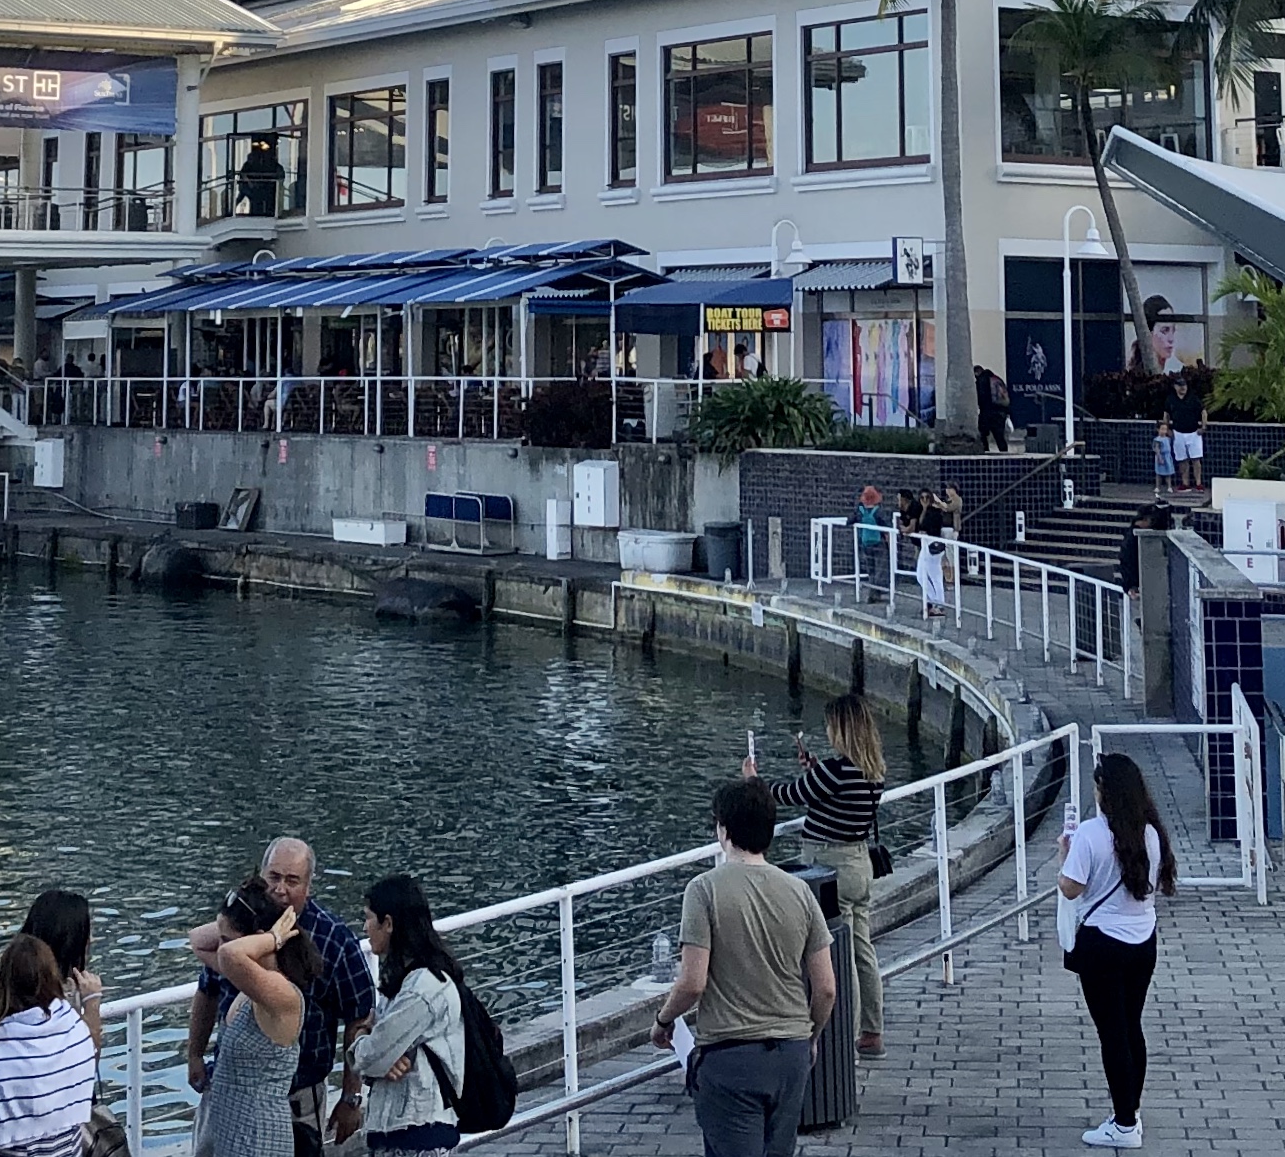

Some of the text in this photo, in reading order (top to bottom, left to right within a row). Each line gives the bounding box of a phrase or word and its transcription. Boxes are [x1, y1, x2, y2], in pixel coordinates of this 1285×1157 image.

[706, 307, 763, 319] BOAT TOUR
[707, 318, 742, 331] TICKETS
[742, 318, 763, 331] HERE
[1025, 383, 1044, 392] POLO
